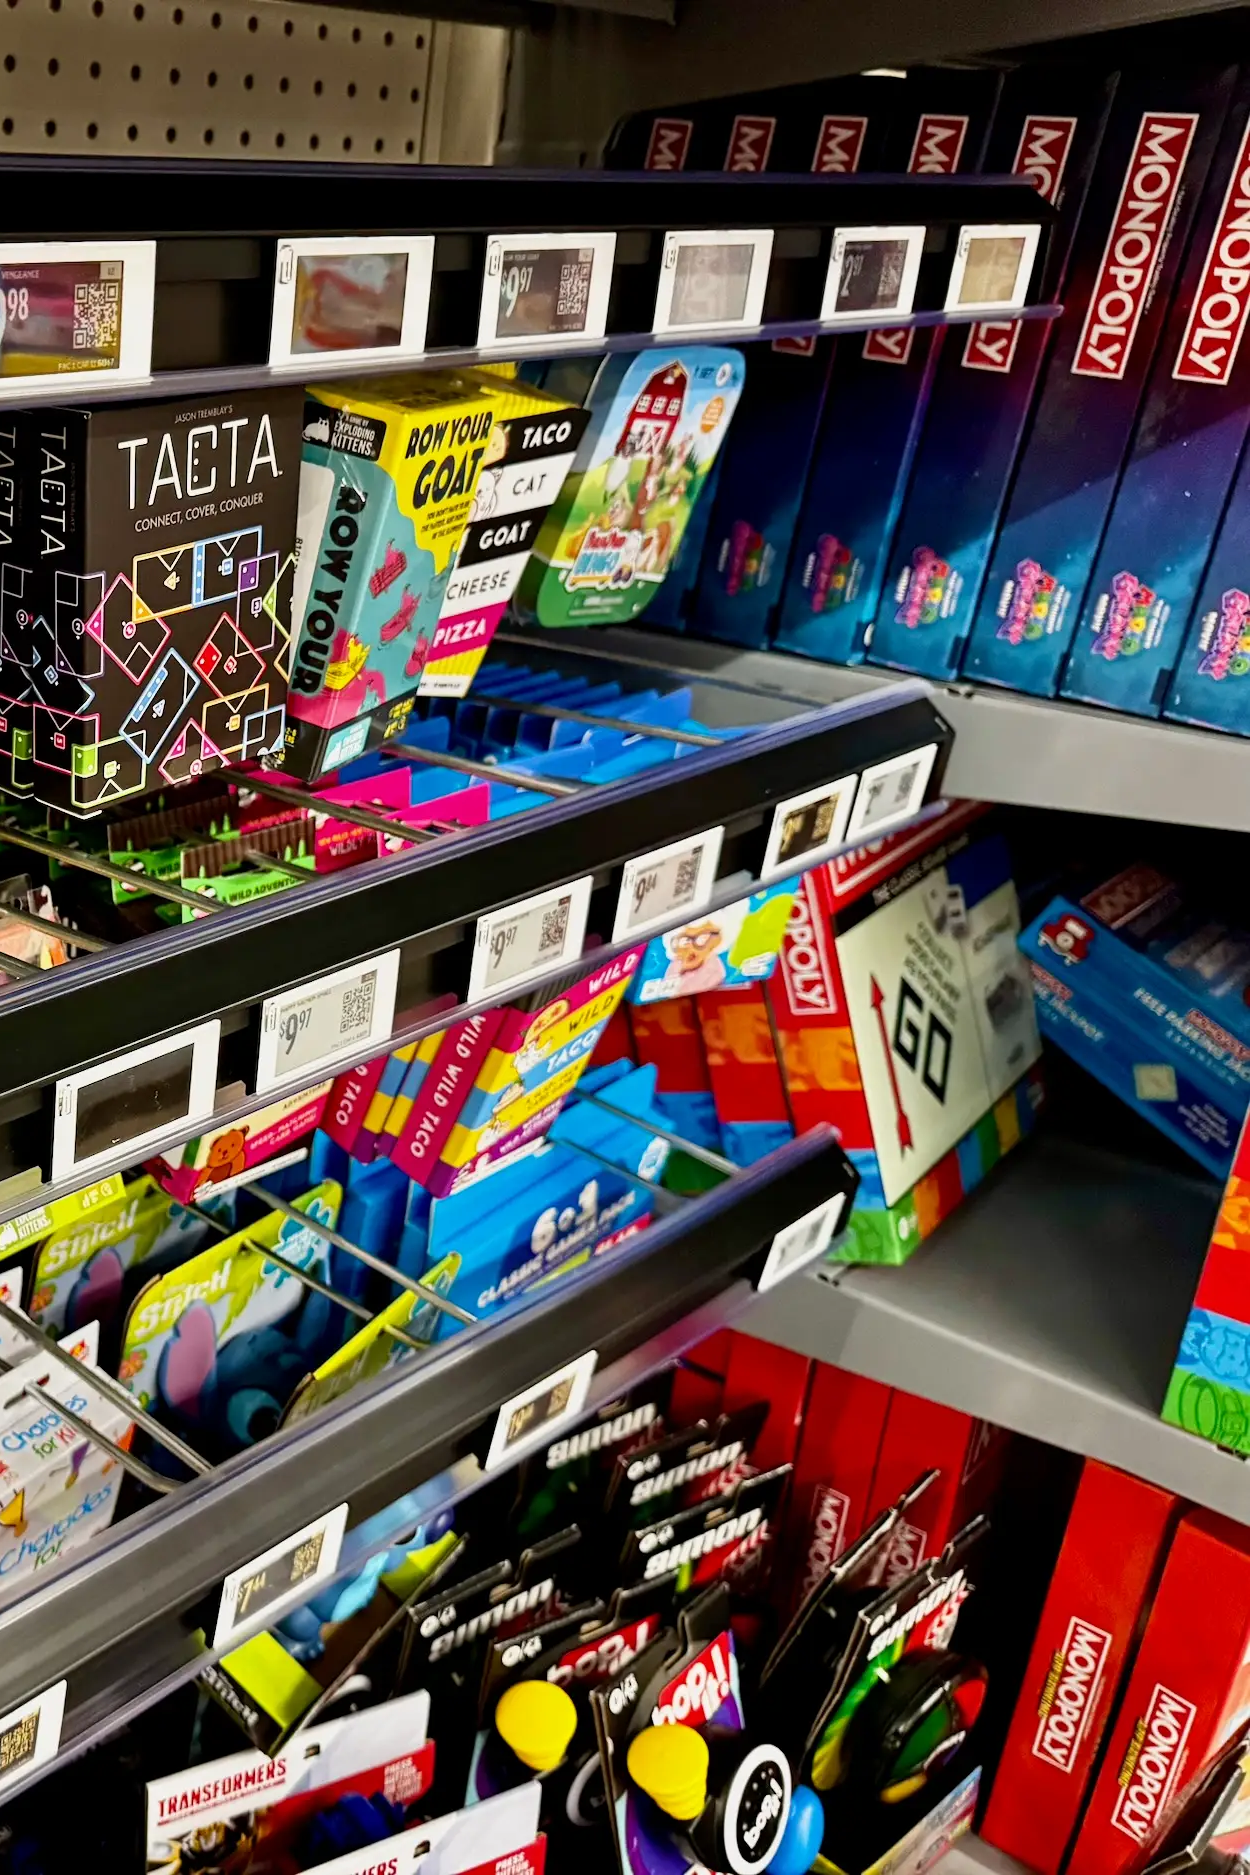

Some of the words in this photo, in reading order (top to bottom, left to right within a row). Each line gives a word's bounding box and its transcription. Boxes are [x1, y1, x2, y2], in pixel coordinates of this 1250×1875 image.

[1086, 123, 1185, 373] MONOPOLY
[174, 409, 197, 424] JASON
[197, 404, 234, 421] TREMBLAY'S
[333, 421, 376, 441] EXPLODING
[404, 420, 448, 459] ROW
[449, 411, 493, 449] YOUR
[522, 421, 573, 450] TACO
[117, 413, 280, 511] TACTA
[331, 432, 373, 457] KITTENS
[40, 427, 66, 556] TACTA
[412, 447, 485, 510] GOAT
[512, 473, 547, 496] CAT
[135, 508, 183, 534] CONNECT,
[184, 501, 218, 525] COVER,
[219, 492, 264, 513] CONQUER
[320, 484, 368, 584] ROW
[479, 522, 533, 551] GOAT
[447, 569, 511, 602] CHEESE
[290, 595, 351, 696] YOUR
[432, 618, 487, 650] PIZZA
[228, 887, 251, 902] WILD
[588, 952, 640, 995] WILD
[456, 1014, 487, 1060] WILD
[569, 993, 616, 1034] WILD
[546, 1029, 600, 1074] TACO
[892, 975, 954, 1107] GO
[335, 1083, 362, 1128] TACO
[433, 1062, 464, 1109] WILD
[410, 1110, 442, 1159] TACO
[1, 1393, 88, 1452] Charaes
[546, 1402, 658, 1470] simon
[32, 1434, 58, 1460] for
[630, 1440, 744, 1507] simon
[643, 1507, 764, 1580] simon
[1042, 1625, 1104, 1768] MONOPOLY
[157, 1757, 288, 1819] TRANSFORMERS
[1121, 1692, 1188, 1845] MONOPOLY
